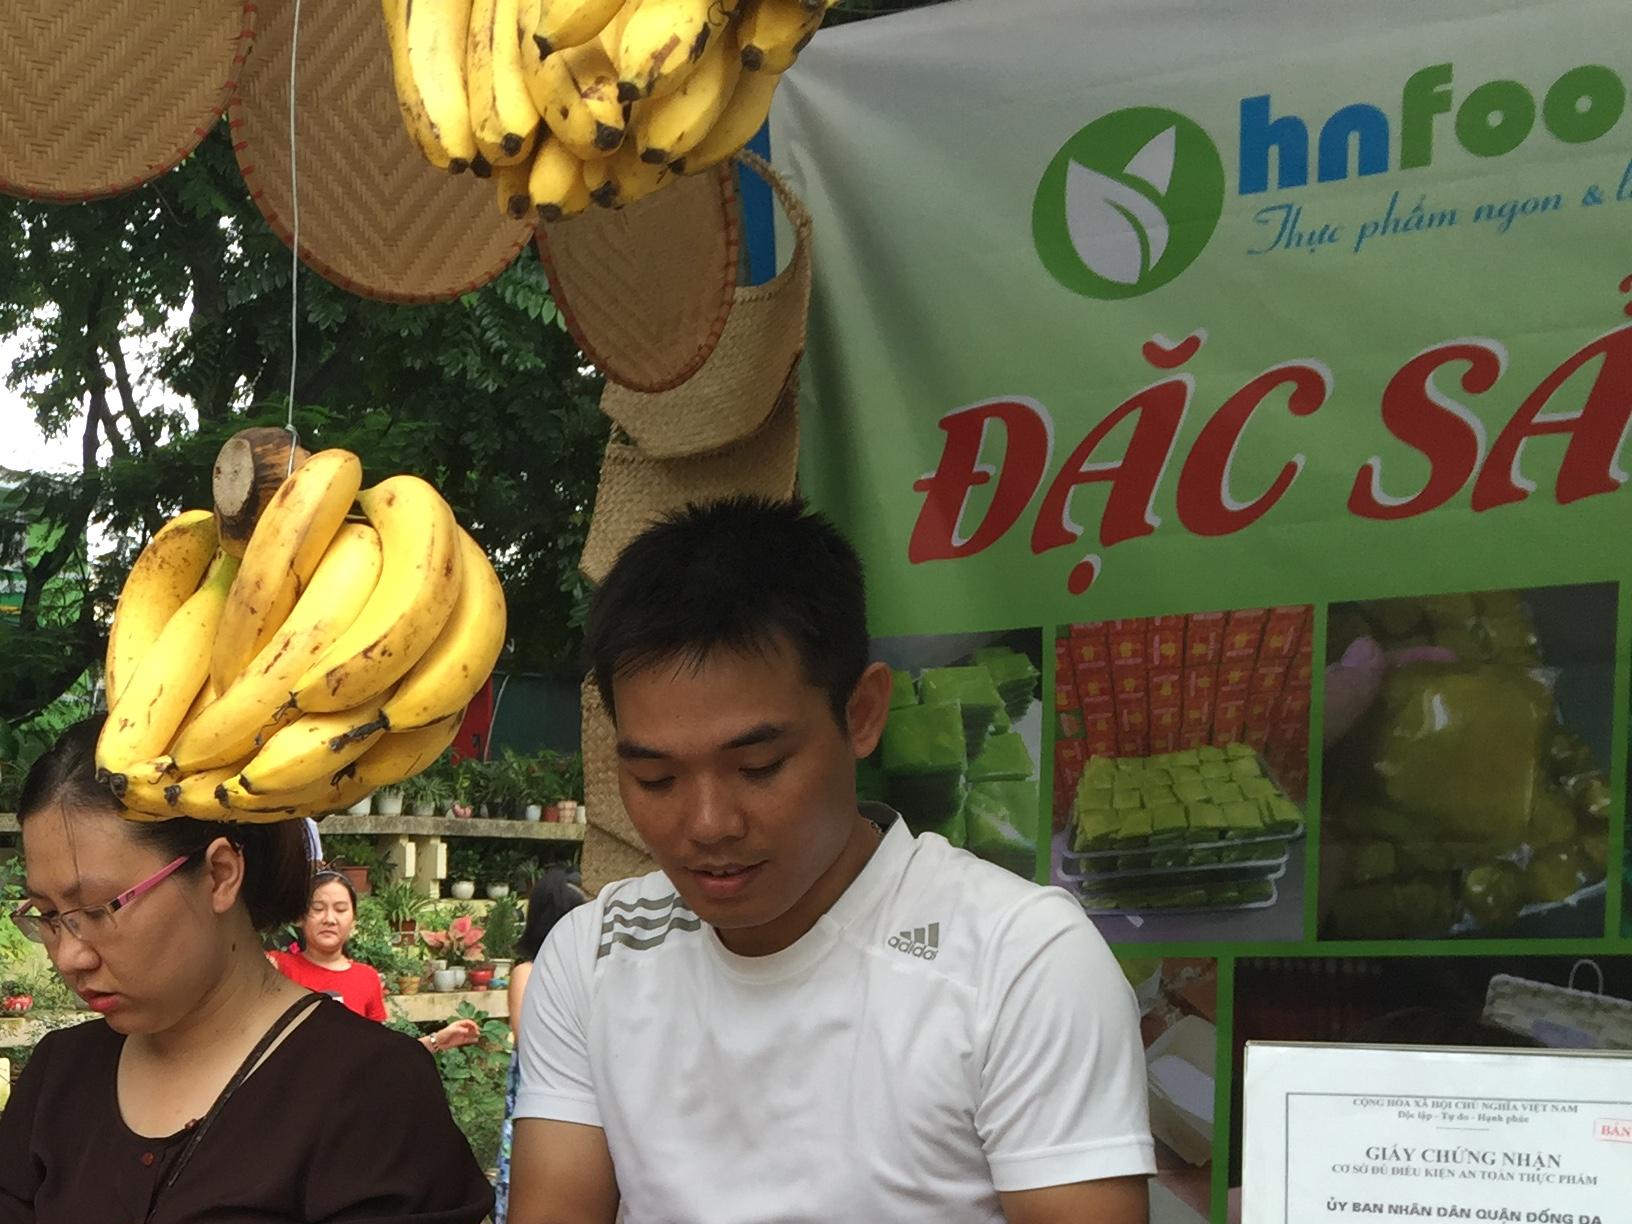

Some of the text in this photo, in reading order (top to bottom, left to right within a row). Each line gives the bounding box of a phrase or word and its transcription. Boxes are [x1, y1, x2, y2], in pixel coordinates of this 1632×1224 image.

[1238, 63, 1625, 195] hnfoo
[1247, 185, 1605, 254] Thực phẩm ngon &
[908, 329, 1333, 596] ĐẶC
[1366, 1144, 1562, 1170] GIẤY CHỨNG NHẬN
[1327, 1197, 1348, 1212] ỦY
[1352, 1201, 1384, 1214] BAN
[1388, 1200, 1433, 1217] NHÂN
[1437, 1202, 1471, 1219] DÂN
[1475, 1206, 1522, 1224] QUẬN
[1526, 1206, 1574, 1224] ĐỐNG
